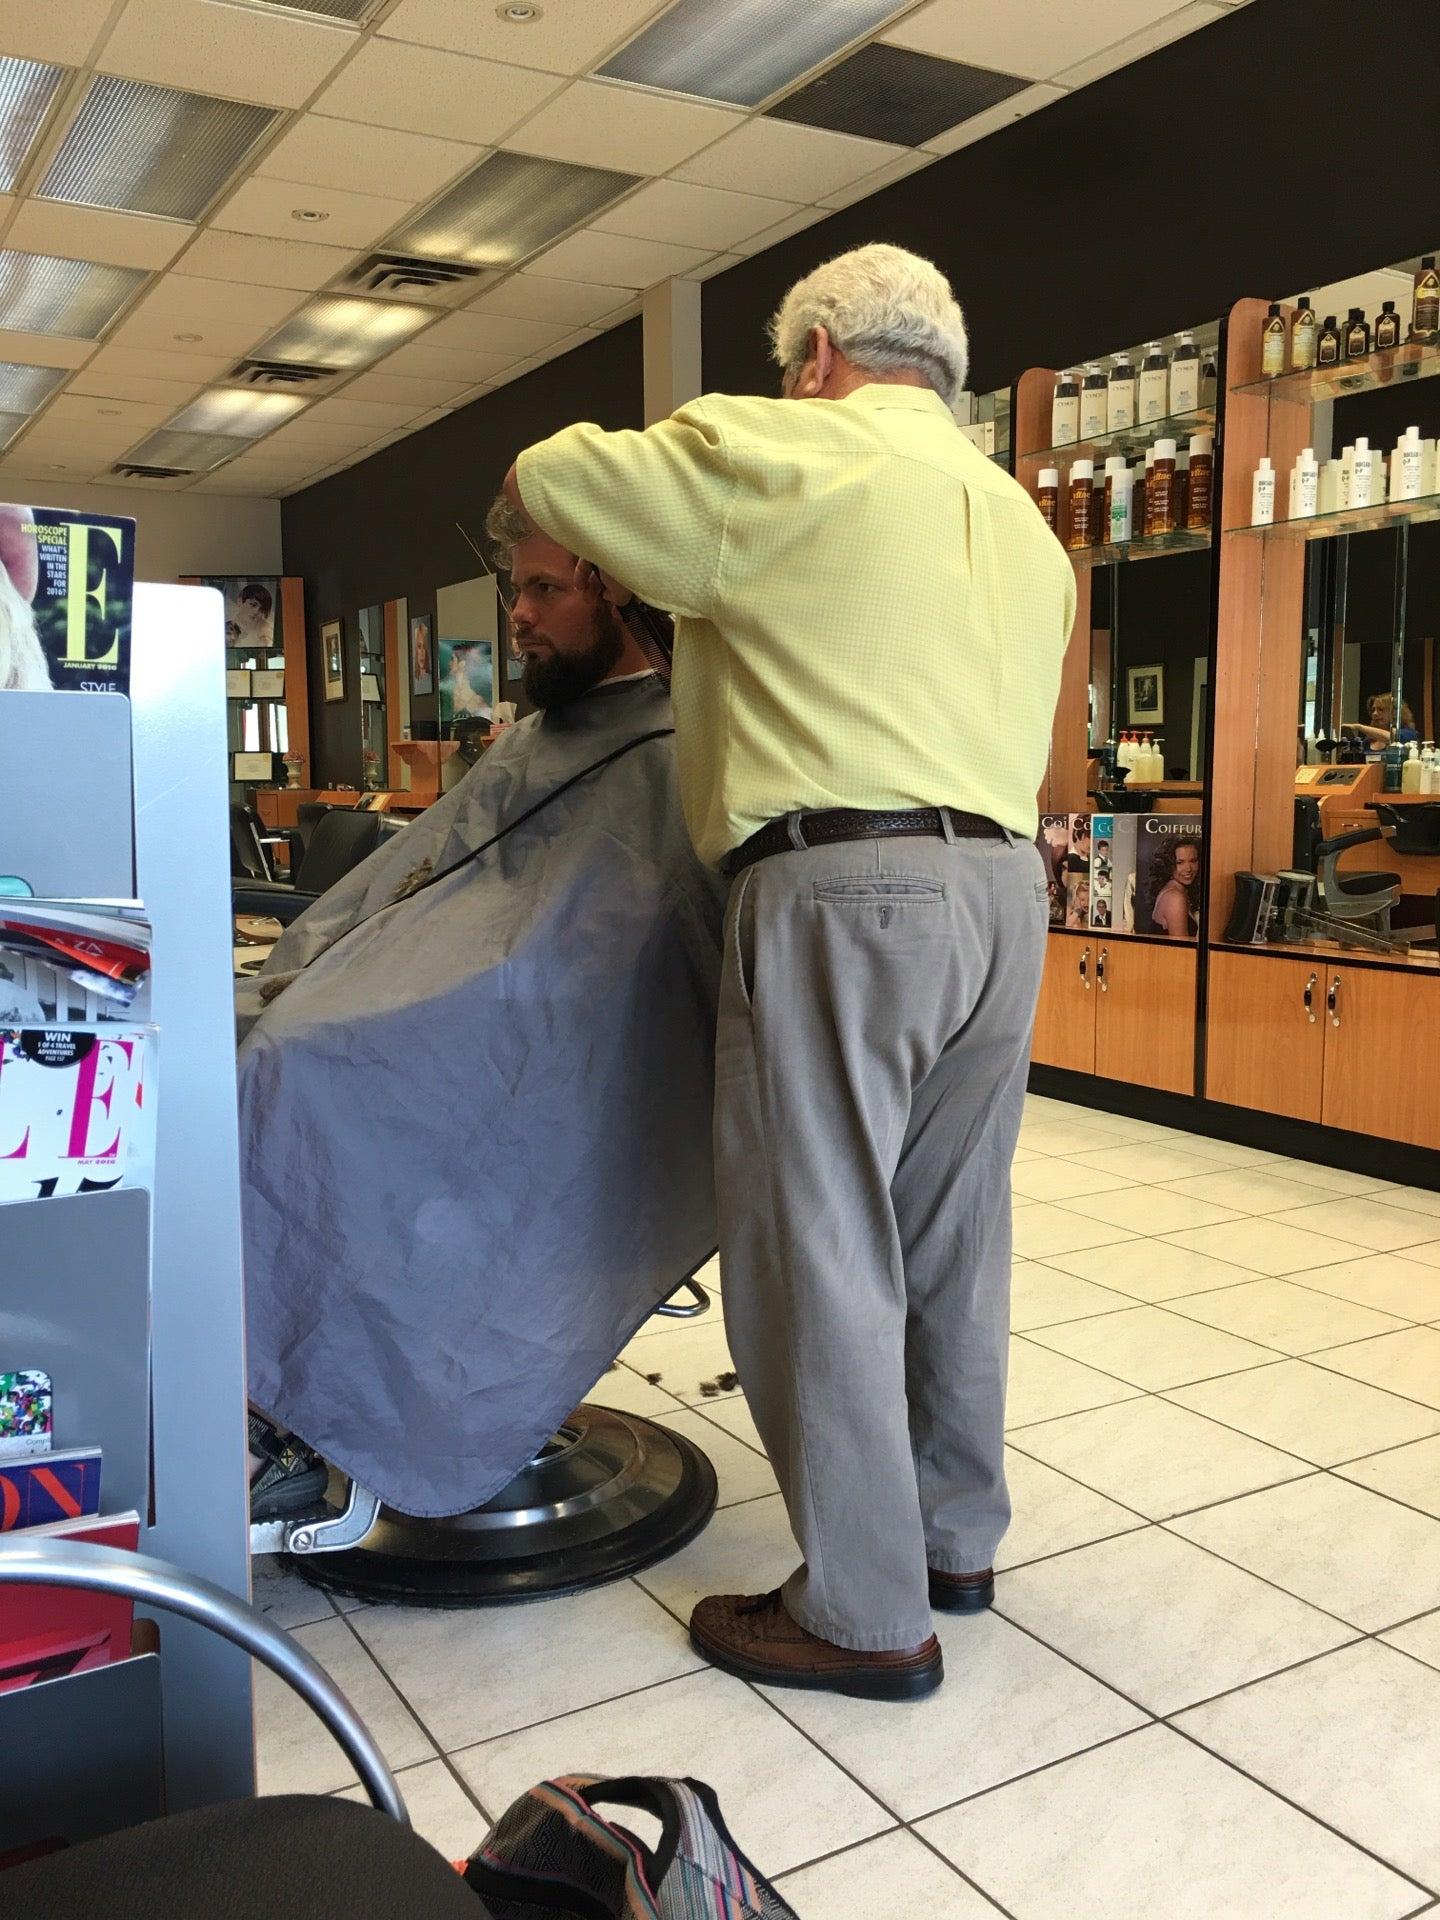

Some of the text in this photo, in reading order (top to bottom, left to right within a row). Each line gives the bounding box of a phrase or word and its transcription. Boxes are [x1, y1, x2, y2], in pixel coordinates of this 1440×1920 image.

[21, 524, 67, 536] HOROSCOPE
[38, 535, 67, 545] SPECIAL
[41, 544, 67, 554] WHAT'S
[40, 553, 67, 562] WRITTEN
[47, 562, 66, 571] IN THE
[47, 570, 66, 579] STARS
[53, 579, 66, 588] FOR
[46, 587, 66, 596] 2016?
[63, 662, 96, 670] JANUARY
[45, 1032, 71, 1042] WIN
